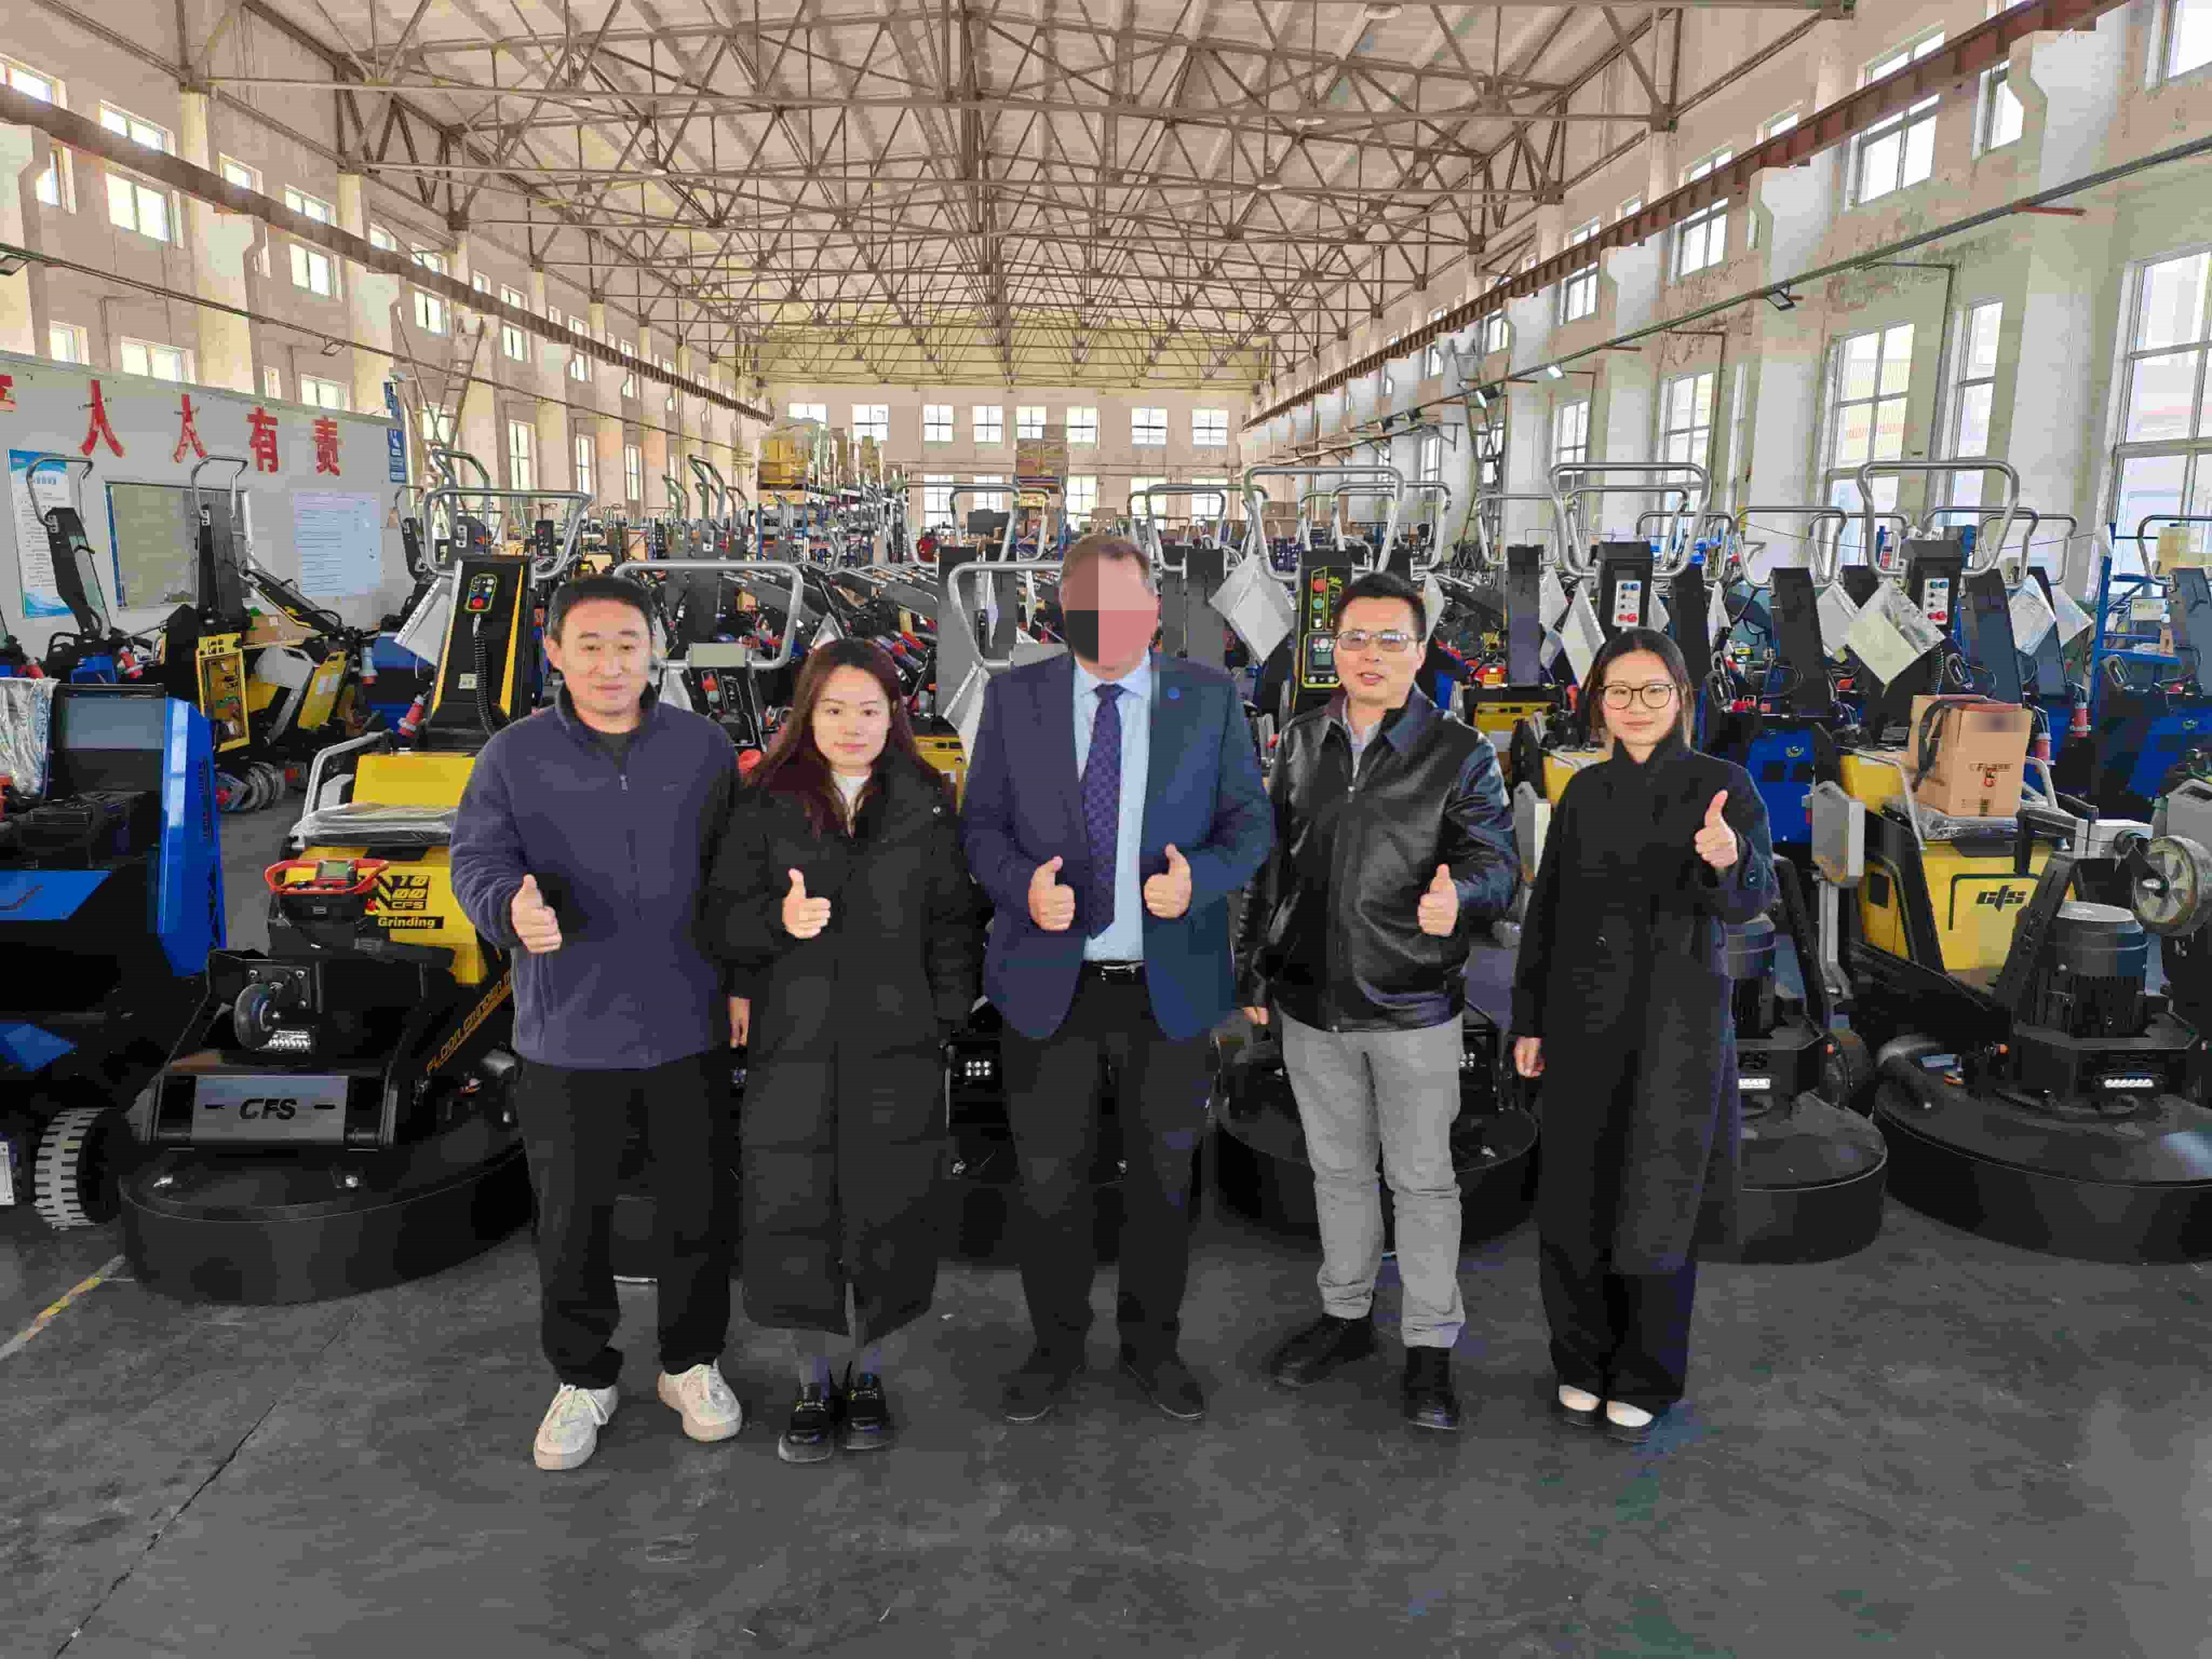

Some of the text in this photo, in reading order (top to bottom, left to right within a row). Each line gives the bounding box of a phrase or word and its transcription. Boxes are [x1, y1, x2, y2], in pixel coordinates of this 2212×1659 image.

[392, 901, 424, 909] CFS
[377, 917, 435, 928] Grinding
[239, 1098, 298, 1120] CFS
